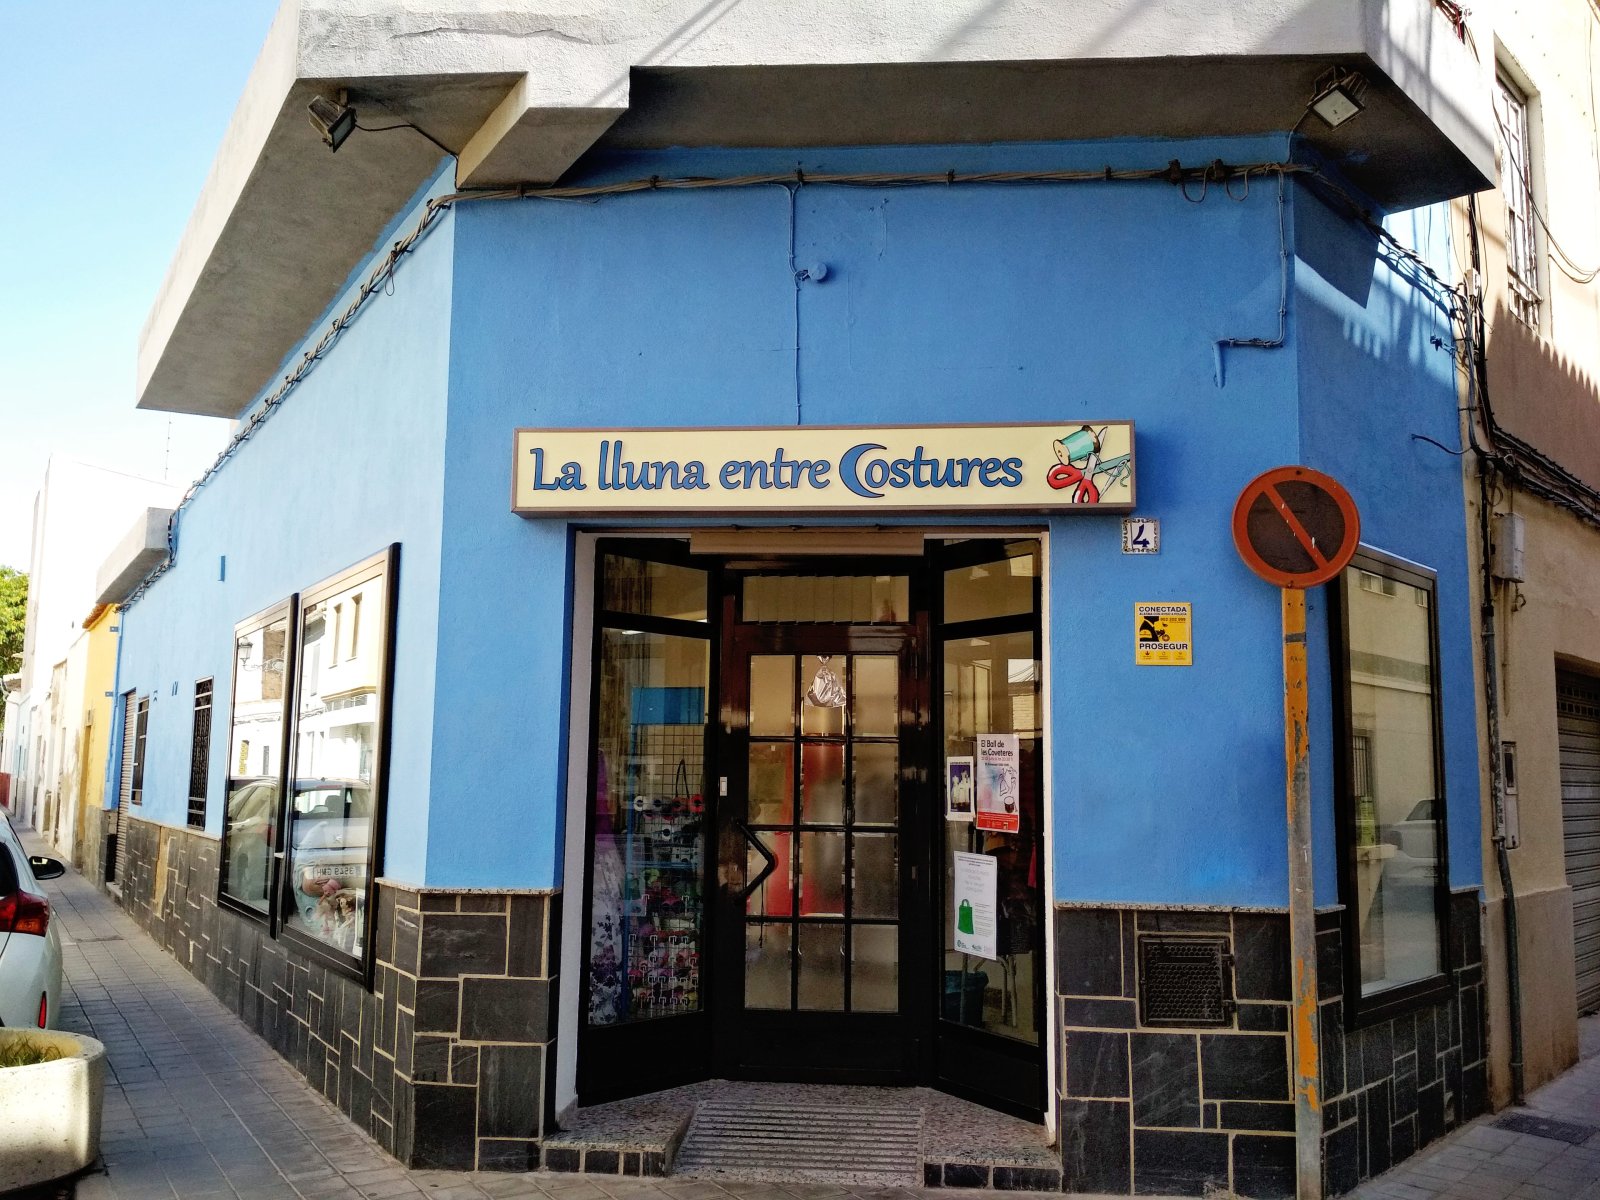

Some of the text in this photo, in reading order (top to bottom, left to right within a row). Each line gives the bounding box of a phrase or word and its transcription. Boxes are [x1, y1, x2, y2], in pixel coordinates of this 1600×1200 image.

[529, 440, 1023, 498] La lluna entre Costures
[1132, 524, 1150, 548] 4
